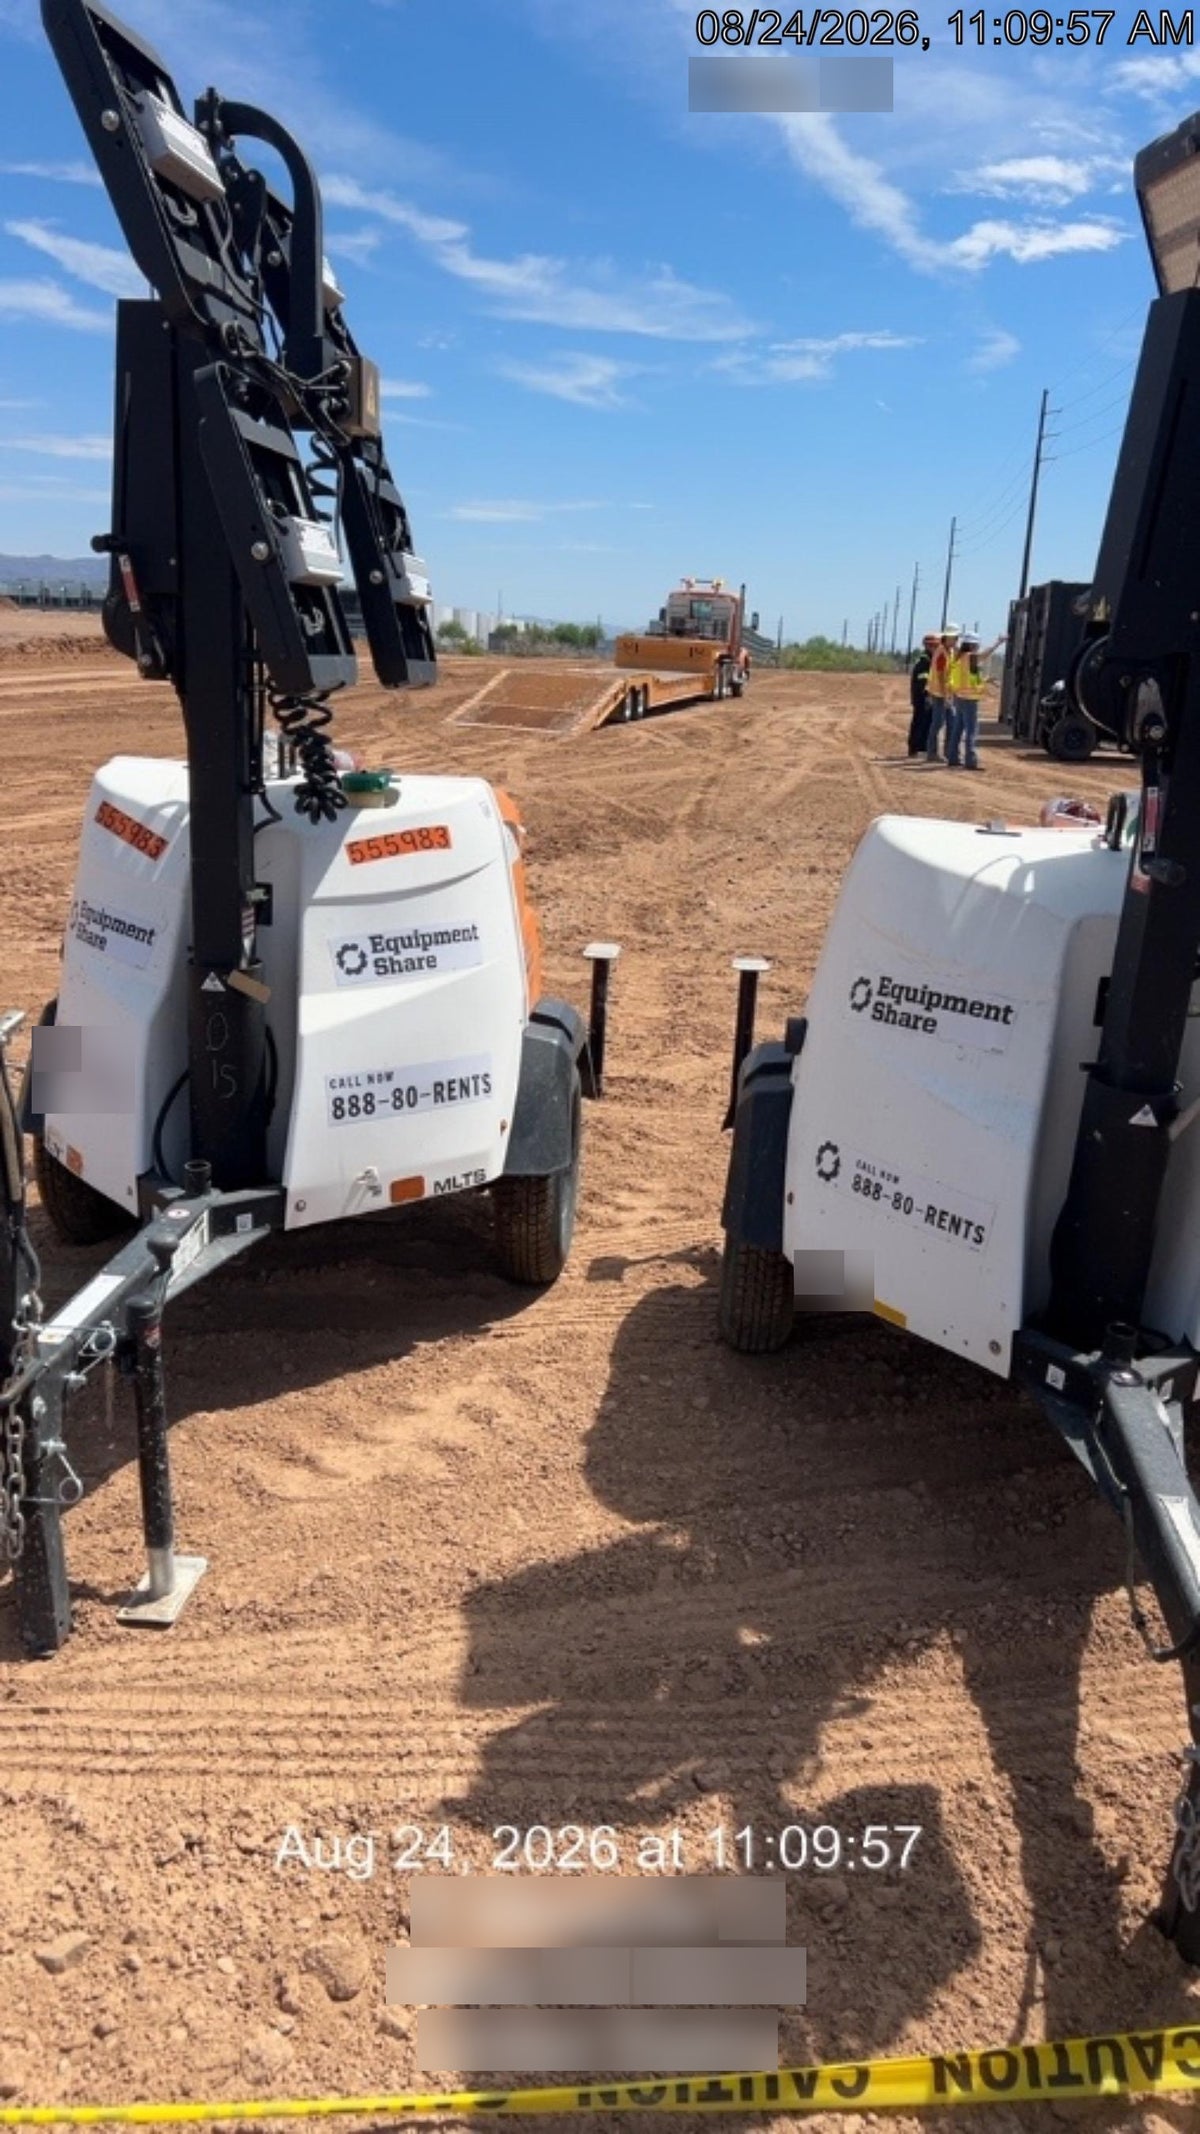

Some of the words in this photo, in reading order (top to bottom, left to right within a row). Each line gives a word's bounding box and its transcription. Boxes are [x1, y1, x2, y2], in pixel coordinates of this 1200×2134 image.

[349, 826, 450, 864] 555983
[76, 922, 108, 951] Share
[79, 900, 156, 946] Equipment
[368, 924, 479, 955] Equipment
[373, 955, 437, 976] Share
[871, 1002, 938, 1034] Share
[877, 976, 1014, 1025] Equipment
[329, 1076, 362, 1089] CALL
[367, 1071, 394, 1084] NOW
[331, 1073, 492, 1120] 888-80-RENTS
[856, 1159, 876, 1176] CALL
[879, 1170, 900, 1184] NOW
[852, 1173, 986, 1245] 888-80-RENTS
[930, 2031, 1200, 2093] CAUTION
